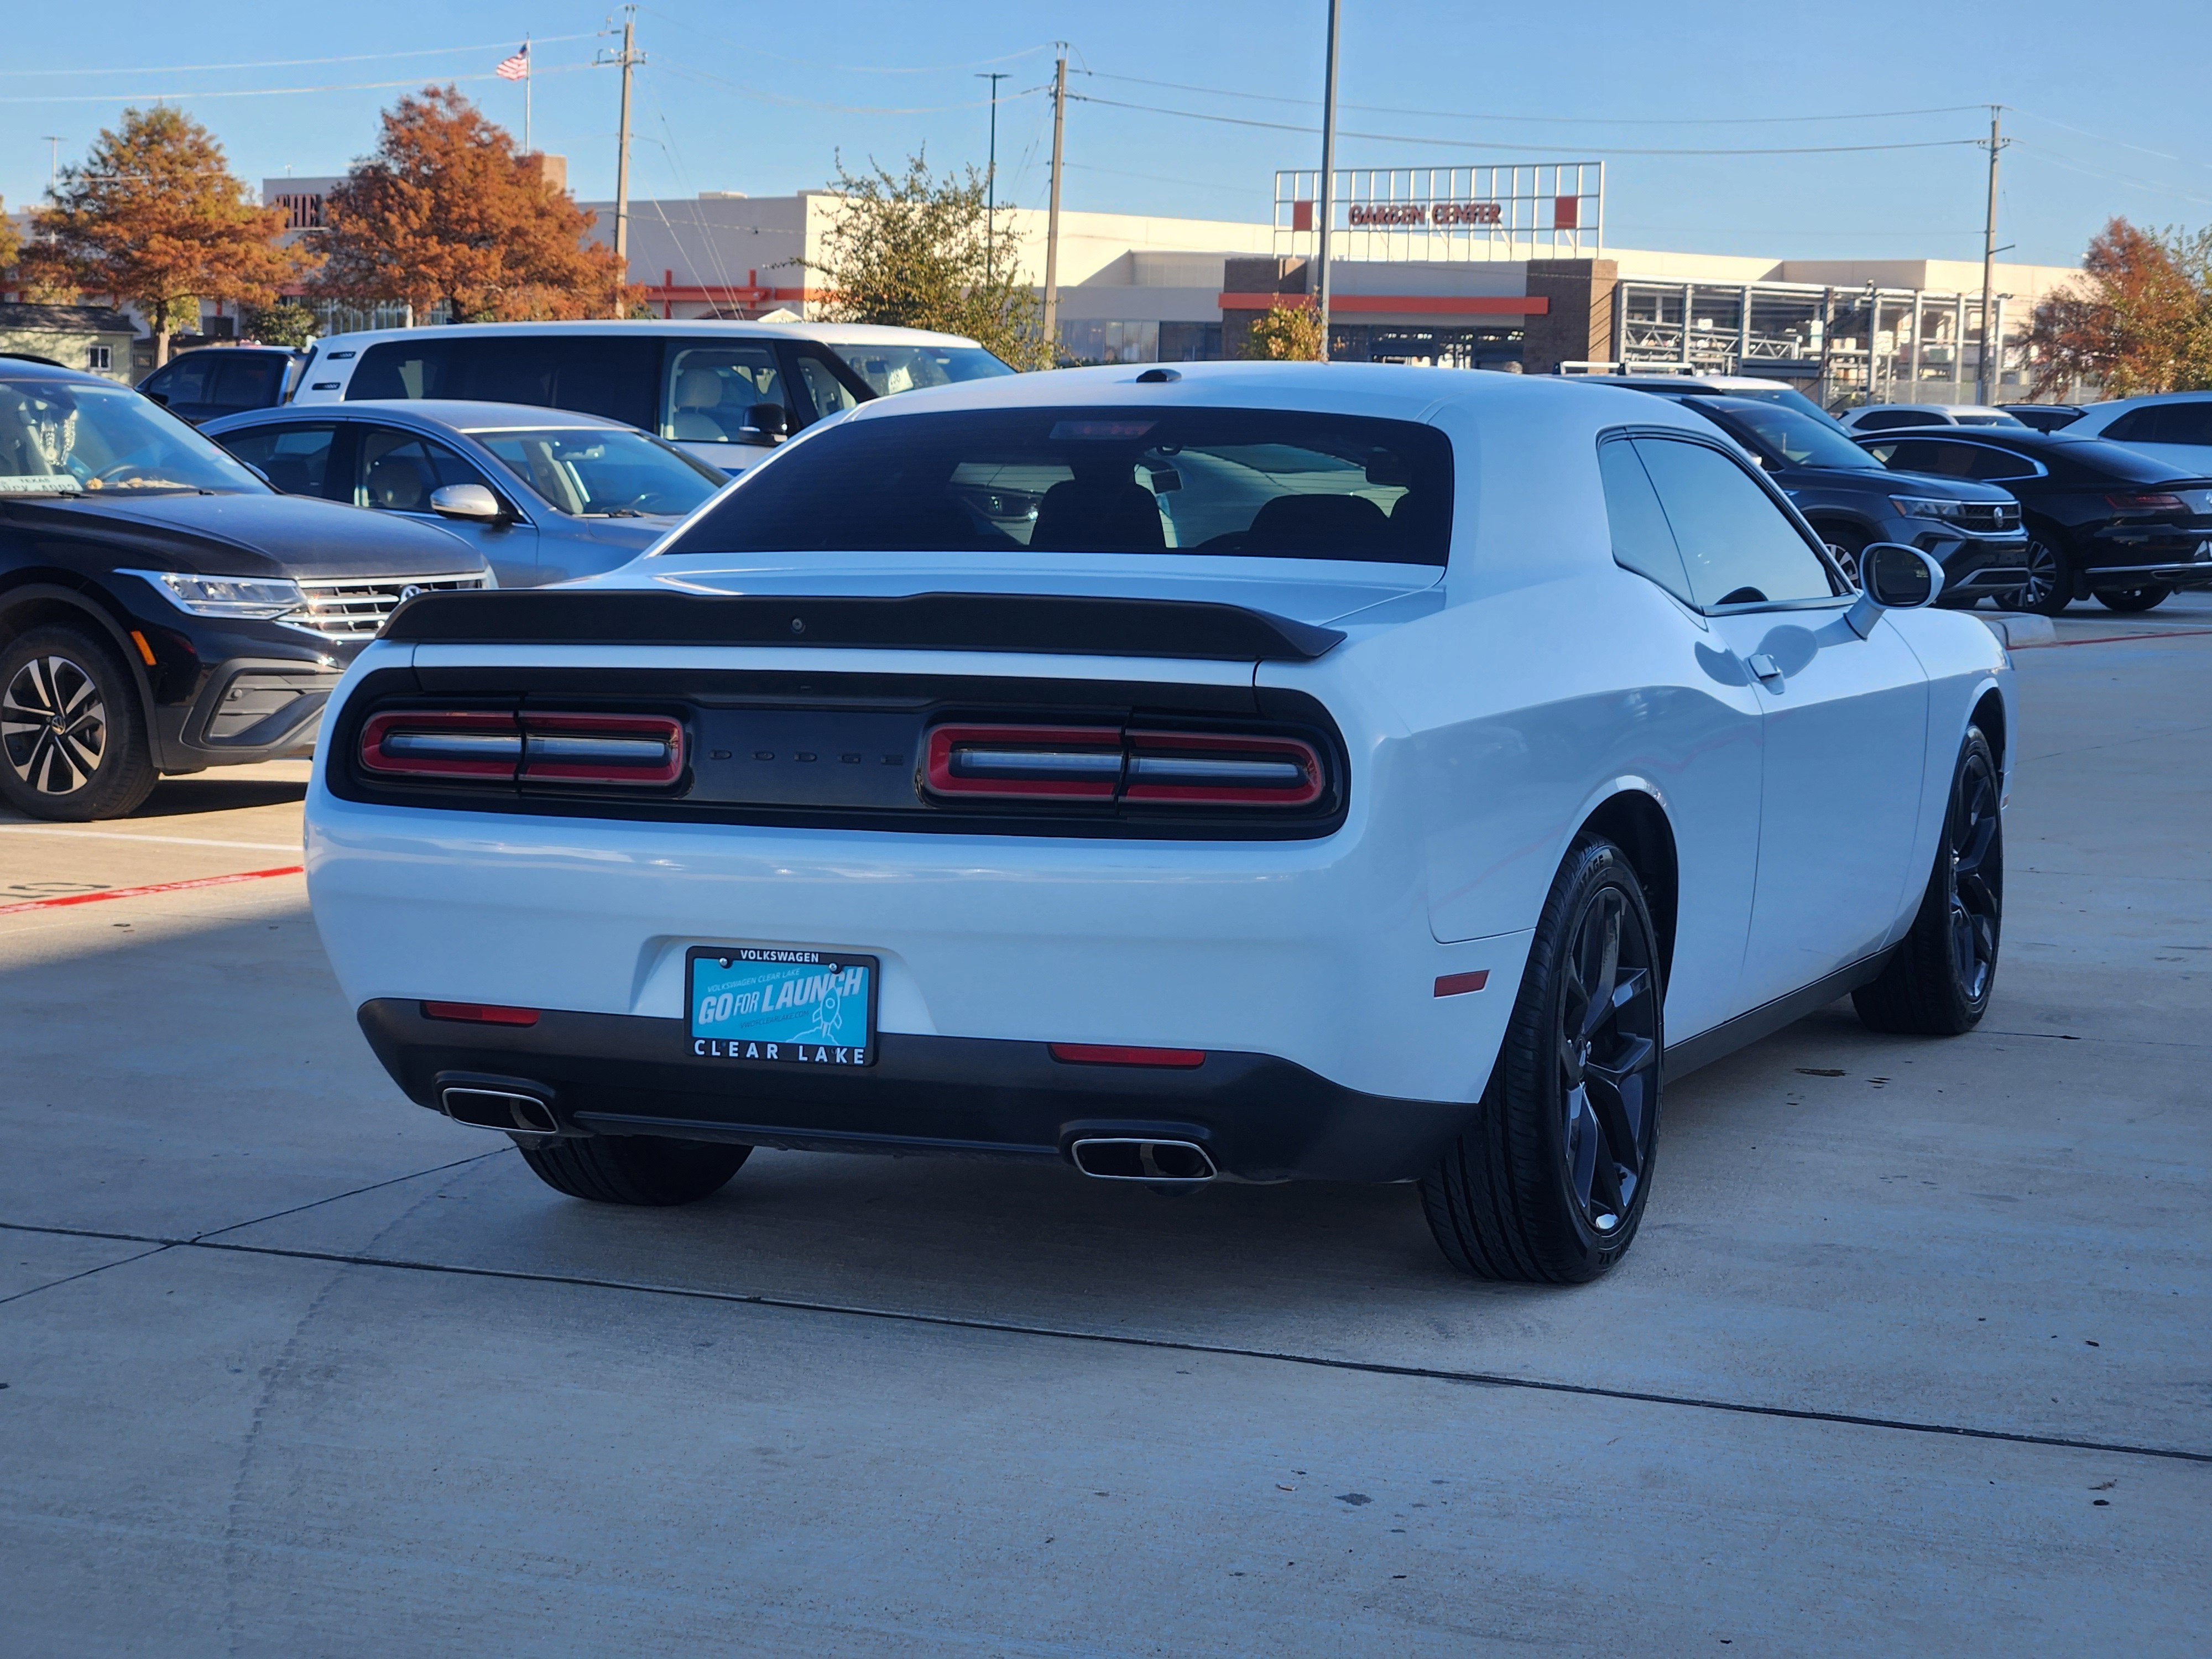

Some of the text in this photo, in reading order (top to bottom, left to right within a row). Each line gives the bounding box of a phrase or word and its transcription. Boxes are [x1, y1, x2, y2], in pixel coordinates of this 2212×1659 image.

[1348, 204, 1501, 226] GARDEN CENTER
[709, 749, 903, 766] DODGE
[740, 950, 819, 963] VOLKSWAGEN
[707, 968, 801, 993] VOLKSWAGEN CLEAR LAKE
[698, 967, 864, 1025] GO FOR LAUNCH
[695, 1039, 864, 1064] CLEAR LAKE
